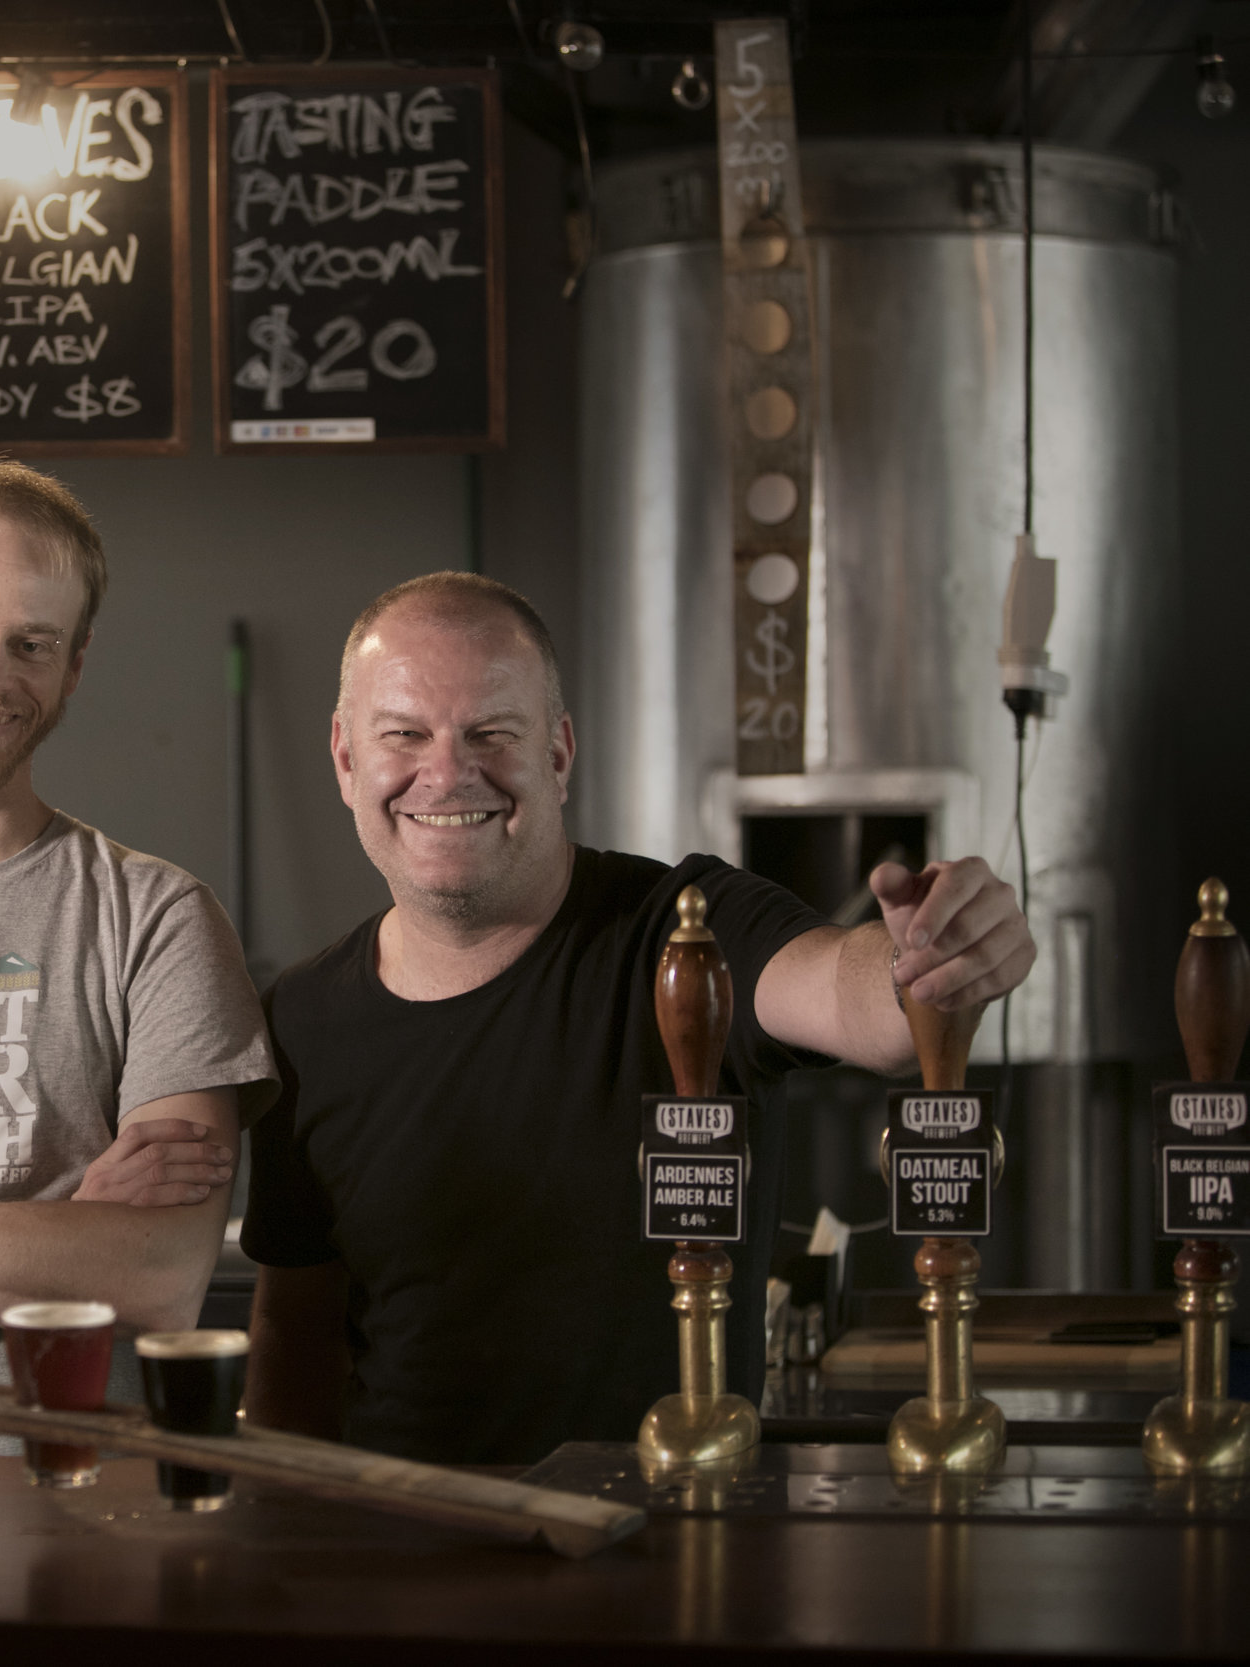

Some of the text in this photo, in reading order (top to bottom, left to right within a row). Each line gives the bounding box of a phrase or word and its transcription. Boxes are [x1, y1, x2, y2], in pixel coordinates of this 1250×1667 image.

[232, 86, 456, 162] TASTING
[233, 160, 470, 232] PADDLE
[26, 324, 108, 367] ABV
[234, 305, 437, 410] $20
[52, 374, 142, 423] $8
[677, 1133, 712, 1144] BREWERY
[654, 1165, 735, 1185] ARDENNES
[900, 1158, 982, 1179] OATMEAL
[1169, 1159, 1250, 1173] BLACK BELGIAN
[654, 1188, 734, 1206] AMBER ALE
[911, 1182, 971, 1204] STOUT
[1189, 1176, 1234, 1204] IIPA
